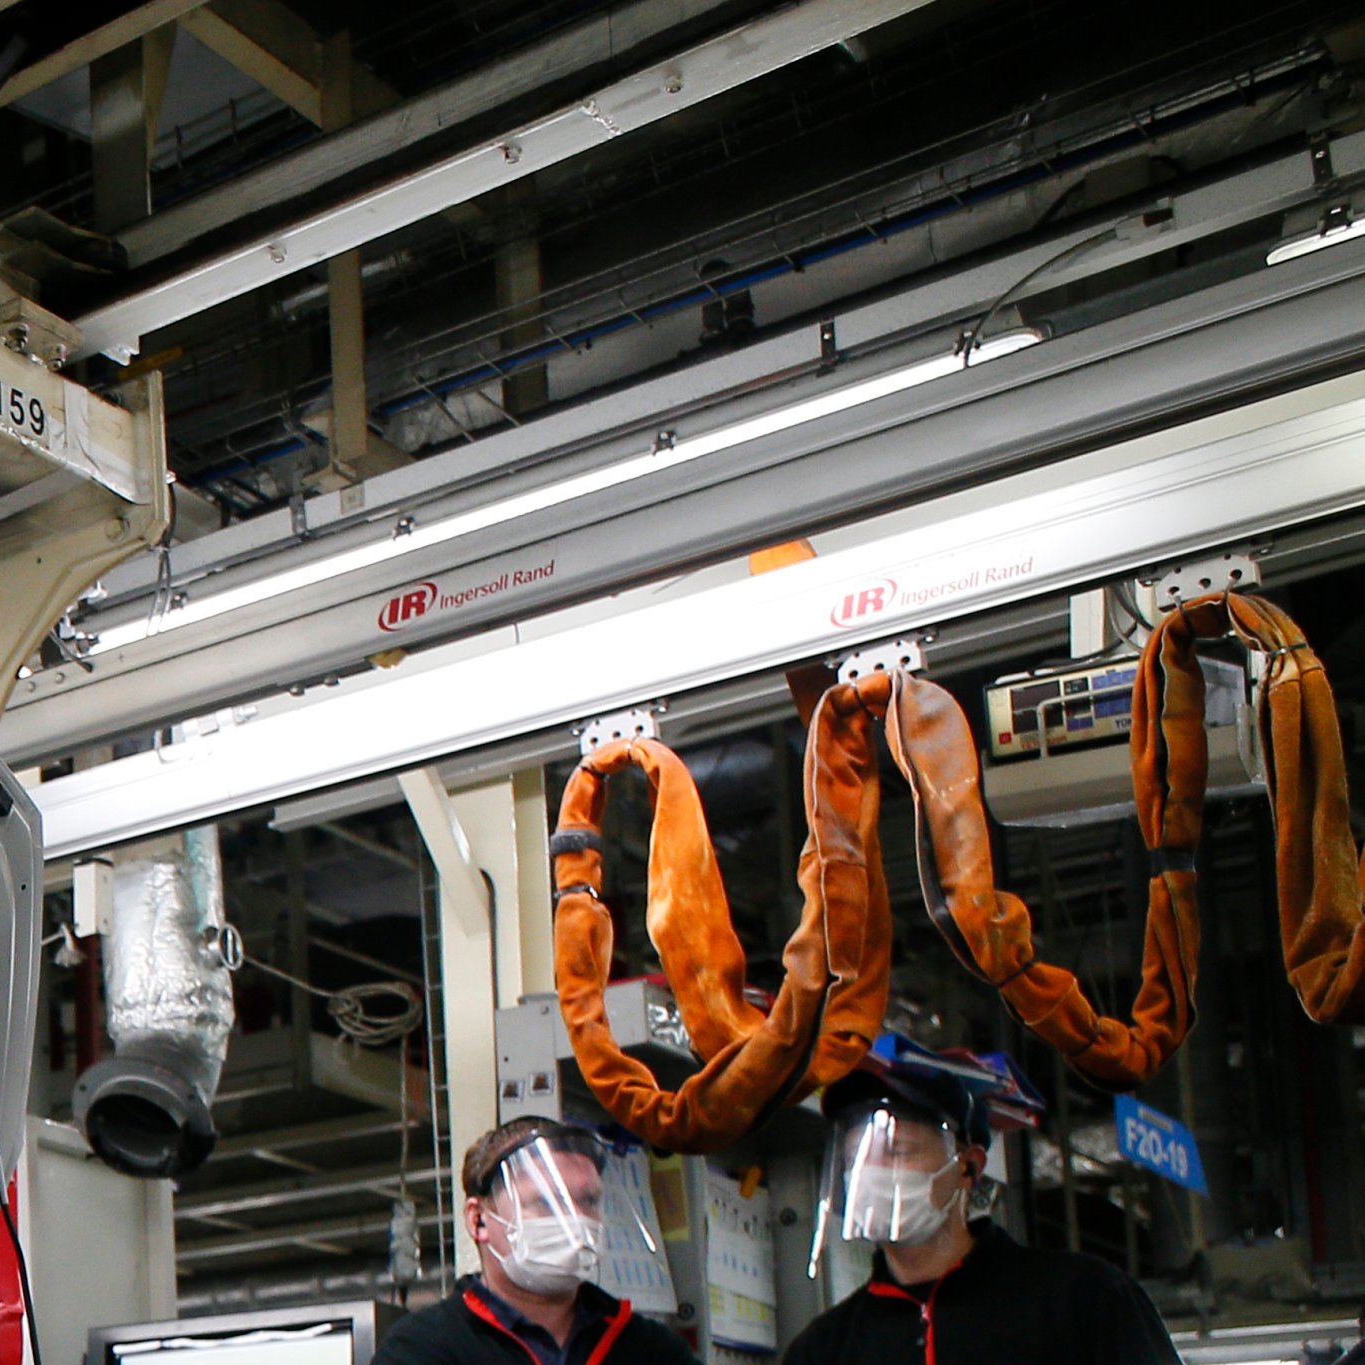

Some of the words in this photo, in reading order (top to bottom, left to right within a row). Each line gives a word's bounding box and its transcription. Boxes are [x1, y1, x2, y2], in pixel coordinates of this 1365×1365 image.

[439, 573, 509, 610] Ingersoll
[512, 559, 556, 587] Rand
[899, 570, 980, 606] Ingersoll
[983, 556, 1034, 585] Rand
